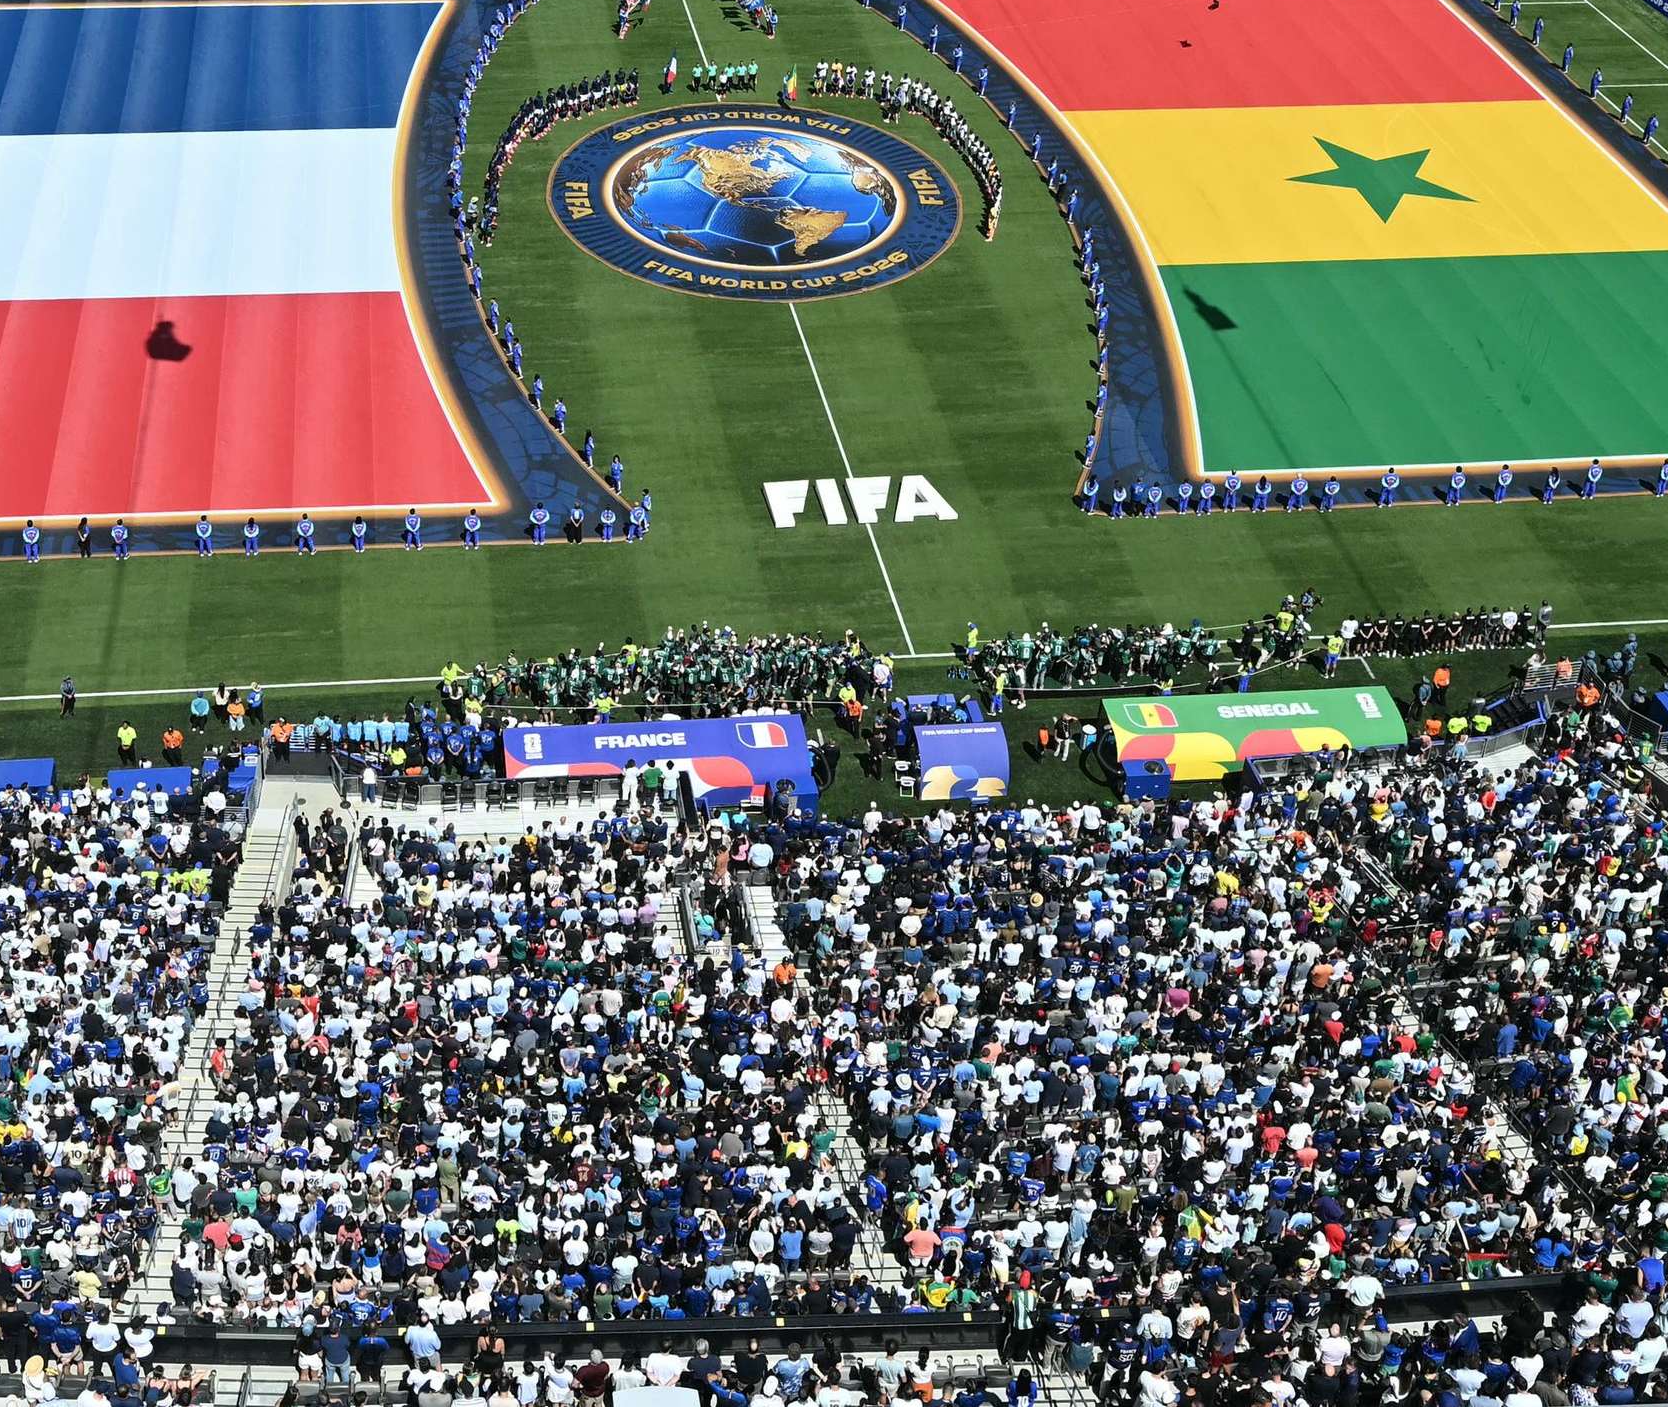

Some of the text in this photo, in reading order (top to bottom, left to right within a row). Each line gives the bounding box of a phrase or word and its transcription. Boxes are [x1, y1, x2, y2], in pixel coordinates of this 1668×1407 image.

[612, 110, 851, 143] FIFA WORLD CUP 2026
[908, 168, 944, 206] FIFA
[563, 181, 595, 220] FIFA
[643, 250, 909, 291] FIFA WORLD CUP 2026
[763, 474, 959, 528] FIFA
[1217, 702, 1319, 719] SENEGAL
[595, 732, 687, 749] FRANCE
[922, 1077, 929, 1085] 7
[71, 1150, 82, 1159] 10
[42, 1195, 53, 1205] 21
[16, 1218, 26, 1228] 10
[20, 1279, 32, 1288] 10
[1275, 1311, 1287, 1321] 10
[1306, 1306, 1321, 1316] 10
